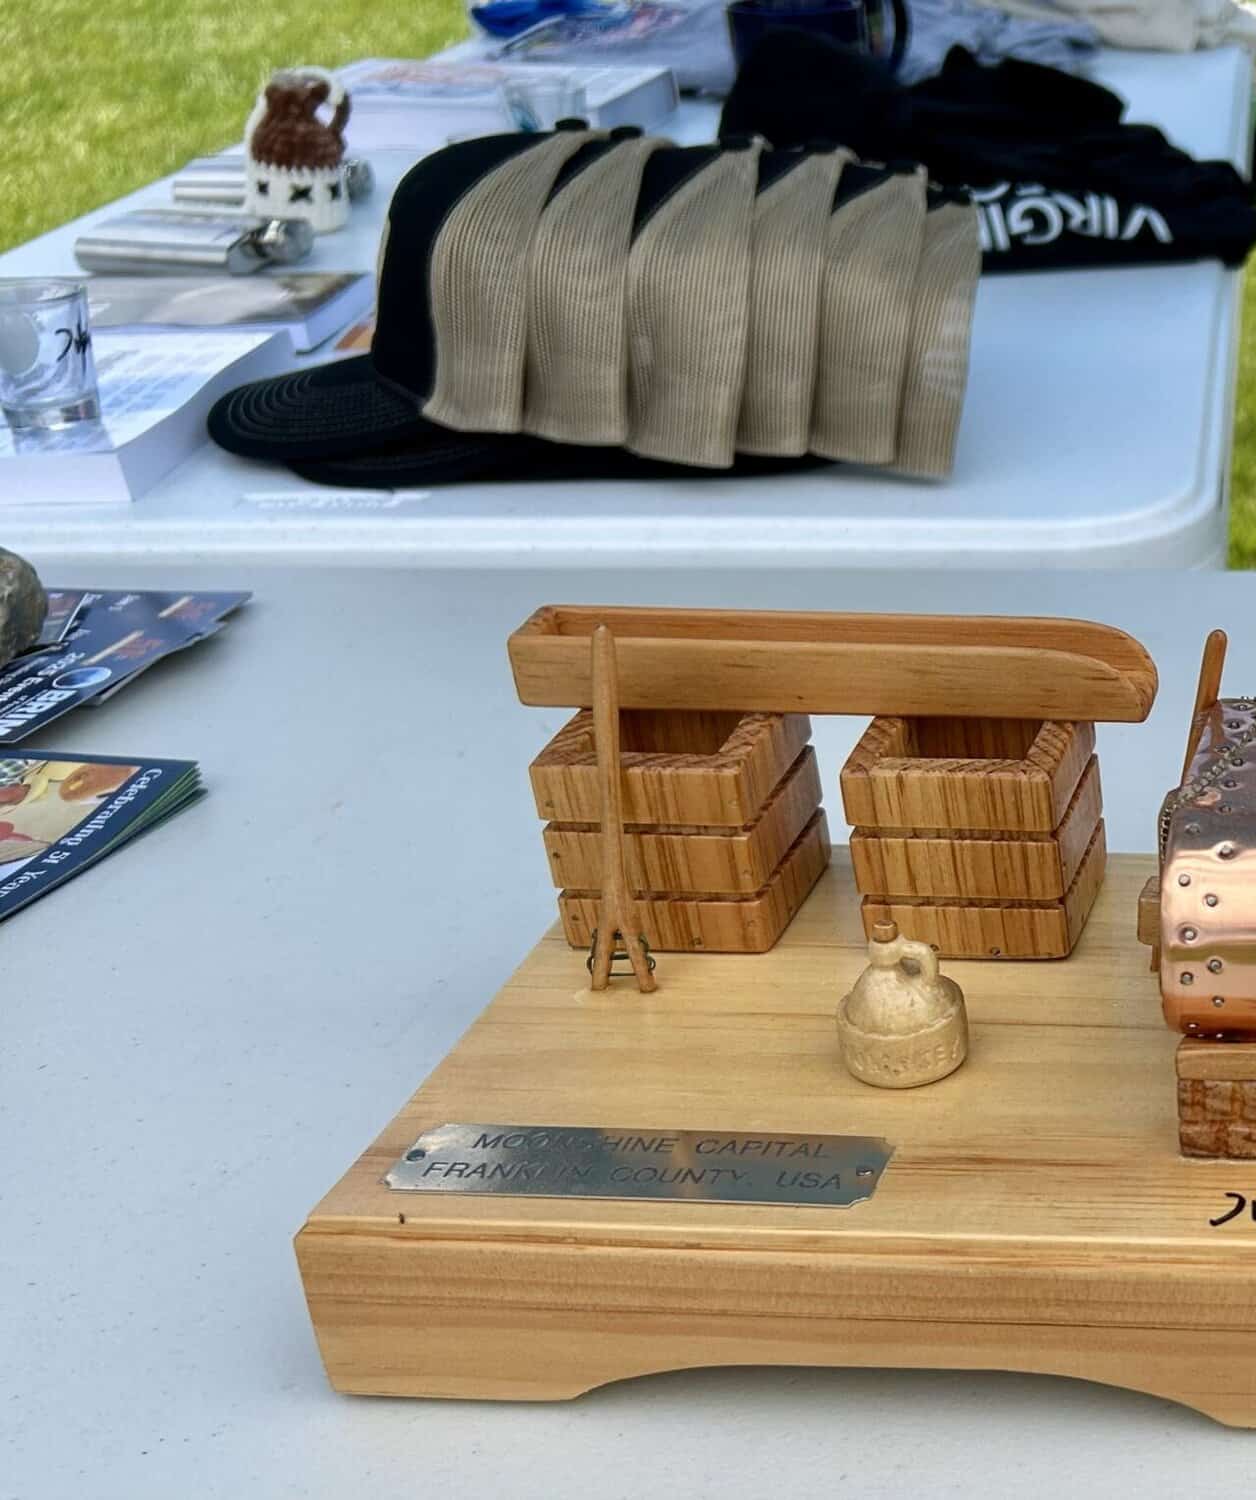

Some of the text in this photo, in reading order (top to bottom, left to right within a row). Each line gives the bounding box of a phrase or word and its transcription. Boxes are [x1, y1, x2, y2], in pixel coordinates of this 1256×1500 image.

[59, 767, 164, 847] Celebrating
[471, 1132, 832, 1159] MOONSHINE CAPITAL
[421, 1160, 594, 1181] FRANKLIN
[775, 1170, 842, 1190] USA
